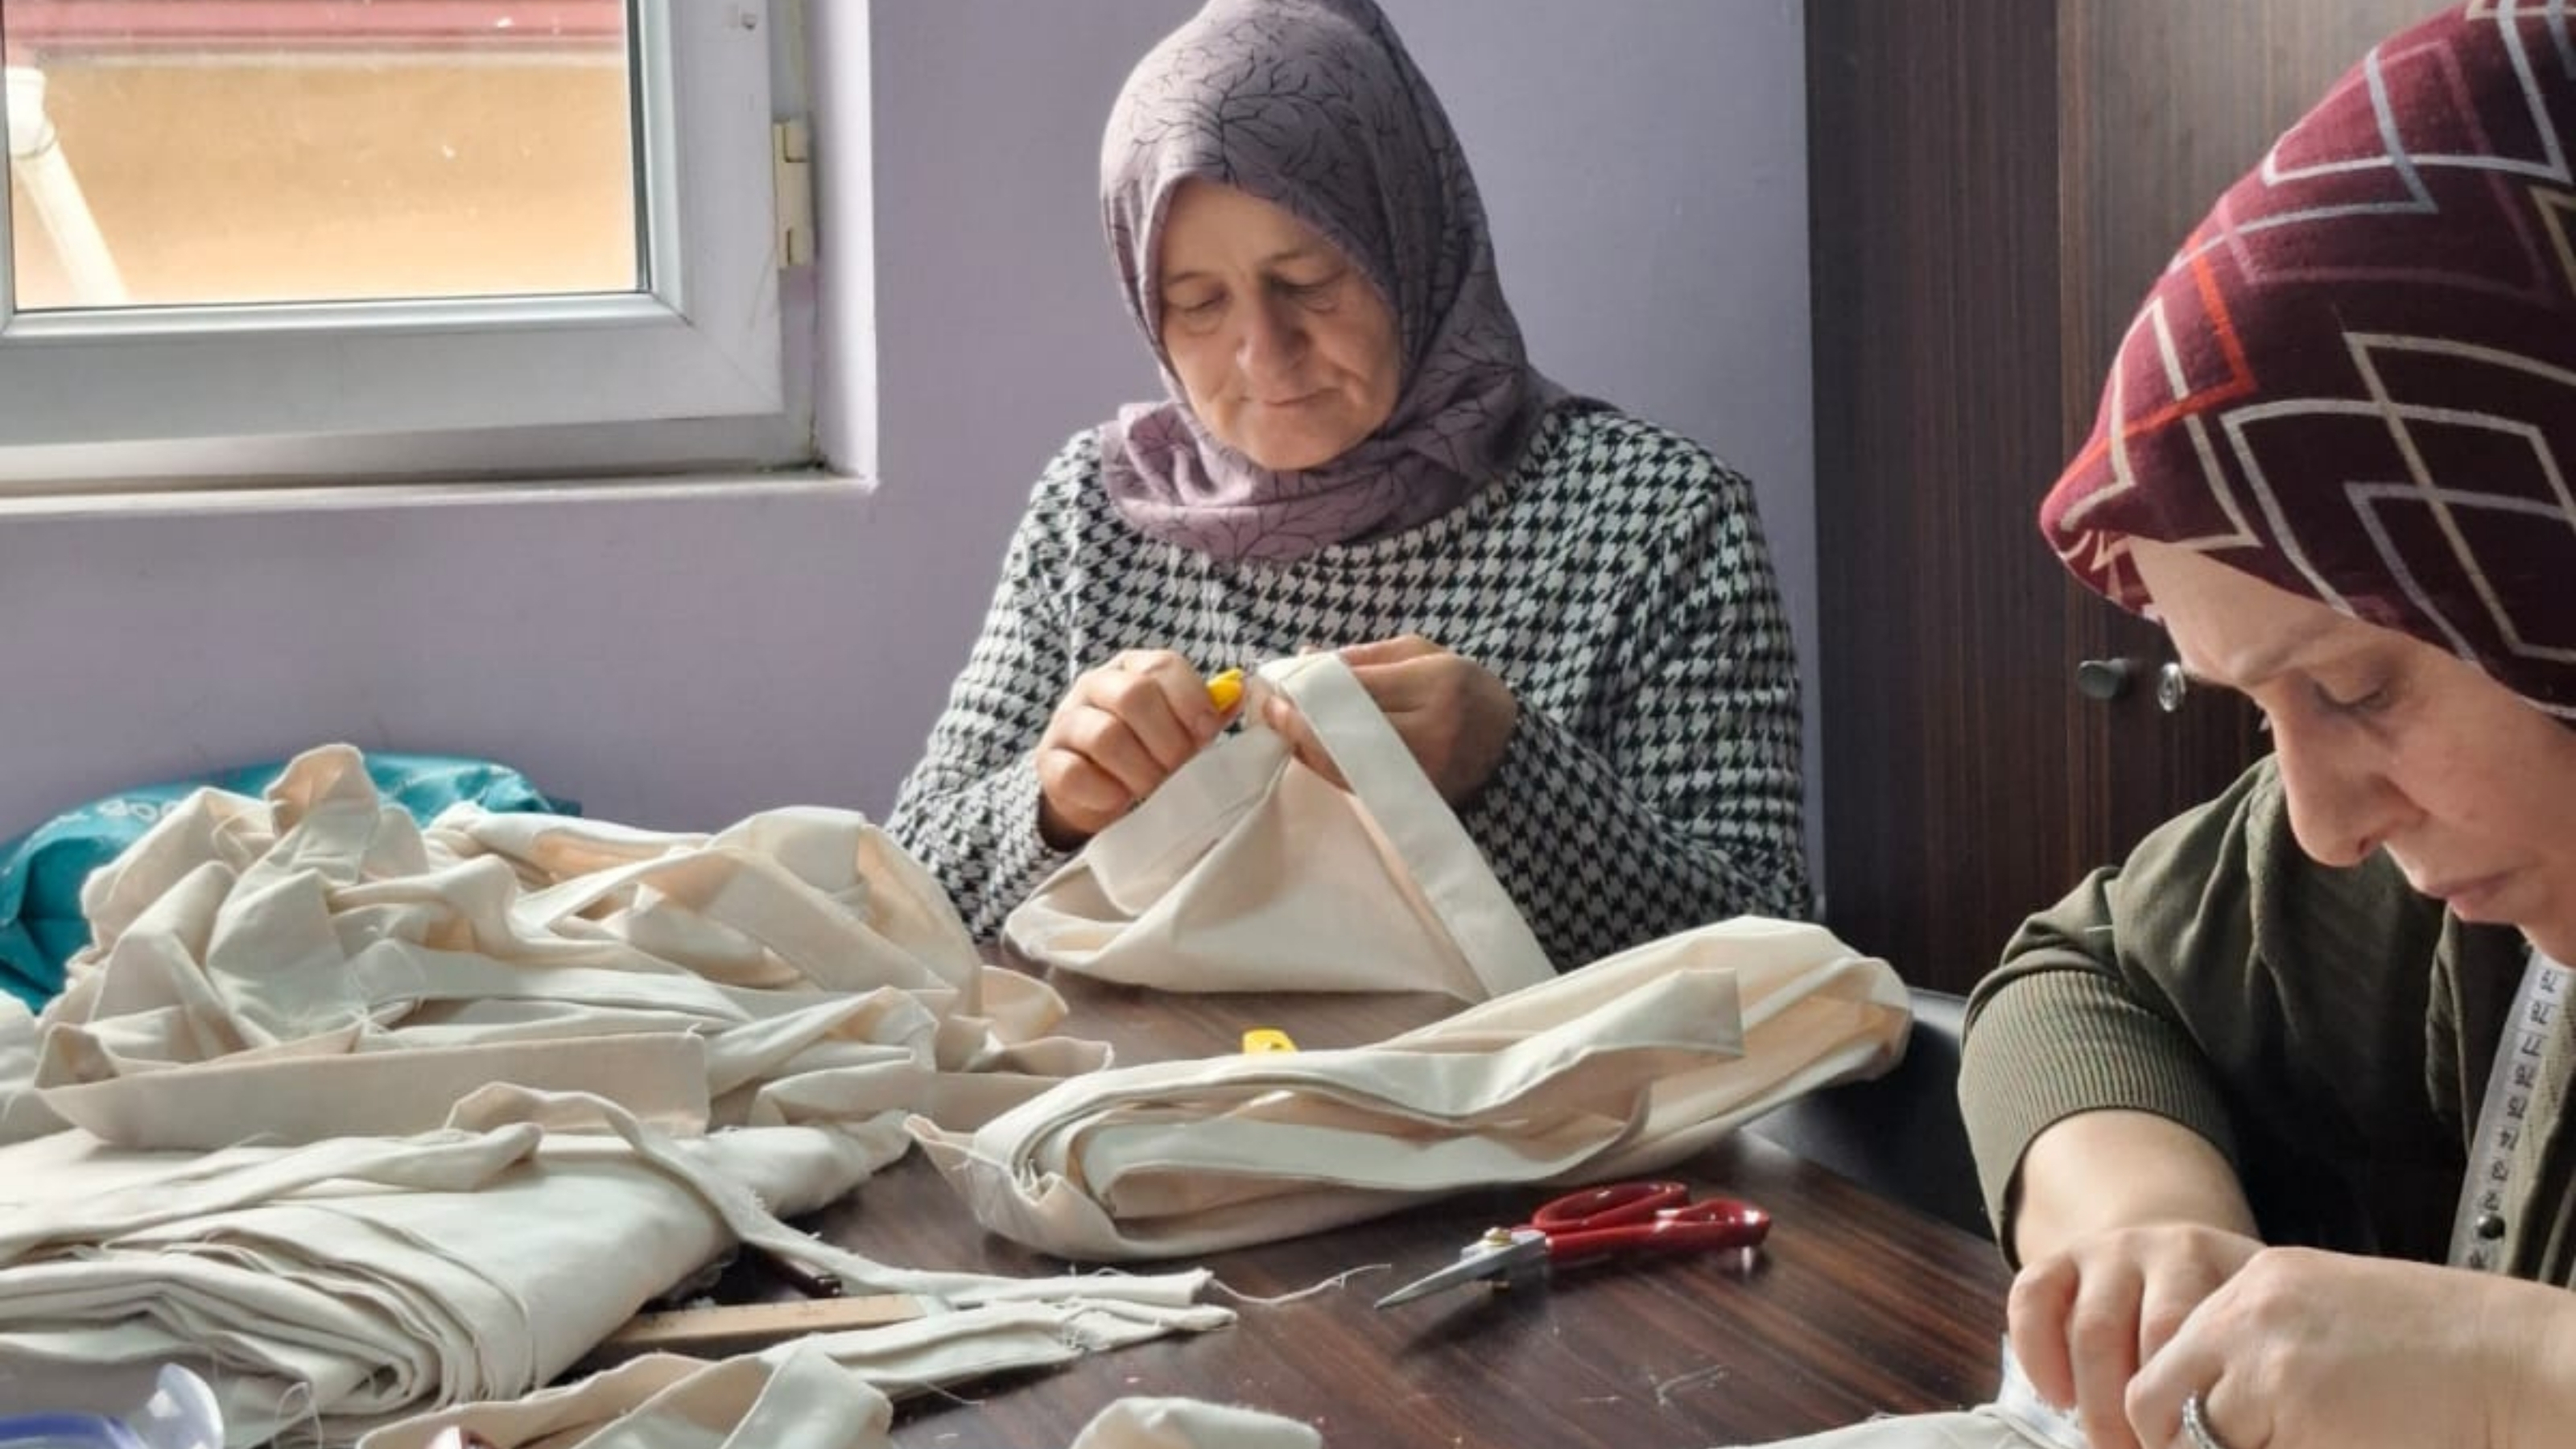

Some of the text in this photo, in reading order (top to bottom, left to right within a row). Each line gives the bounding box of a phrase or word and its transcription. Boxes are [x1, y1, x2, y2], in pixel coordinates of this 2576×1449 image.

[2521, 1035, 2542, 1056] 77
[2514, 1063, 2536, 1088] 76
[2508, 1096, 2527, 1119] 75
[2500, 1129, 2520, 1150] 74
